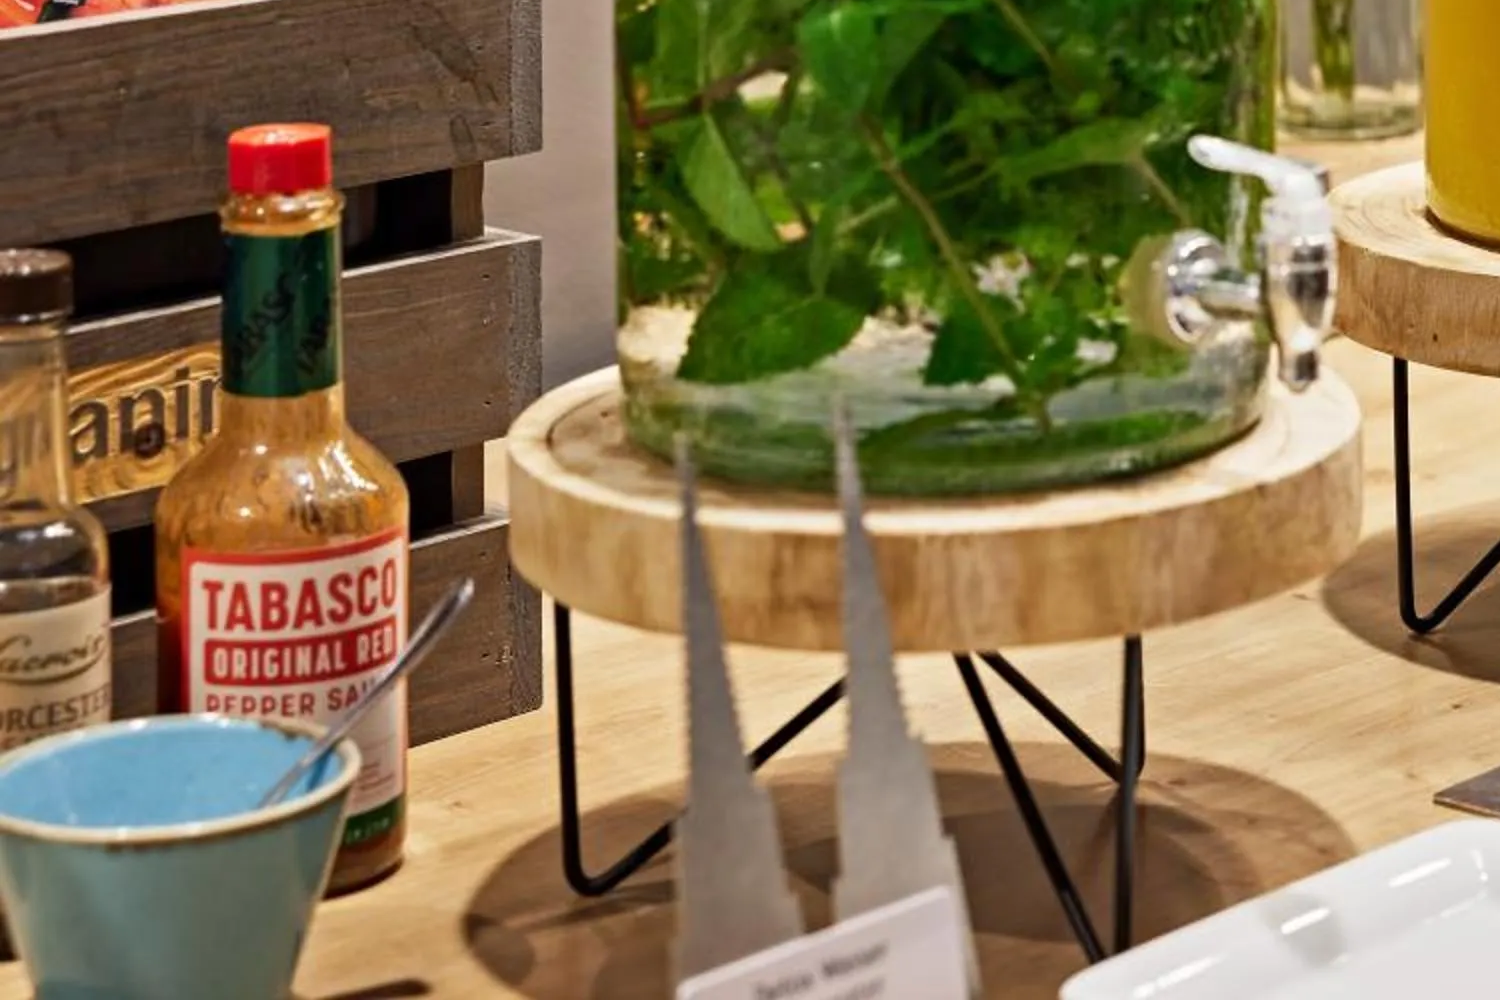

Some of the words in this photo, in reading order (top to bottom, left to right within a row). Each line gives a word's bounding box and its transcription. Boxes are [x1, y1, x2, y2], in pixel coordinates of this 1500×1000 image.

[202, 557, 397, 632] TABASCO
[212, 639, 347, 680] ORIGINAL
[356, 624, 394, 666] RED
[206, 692, 316, 716] PEPPER
